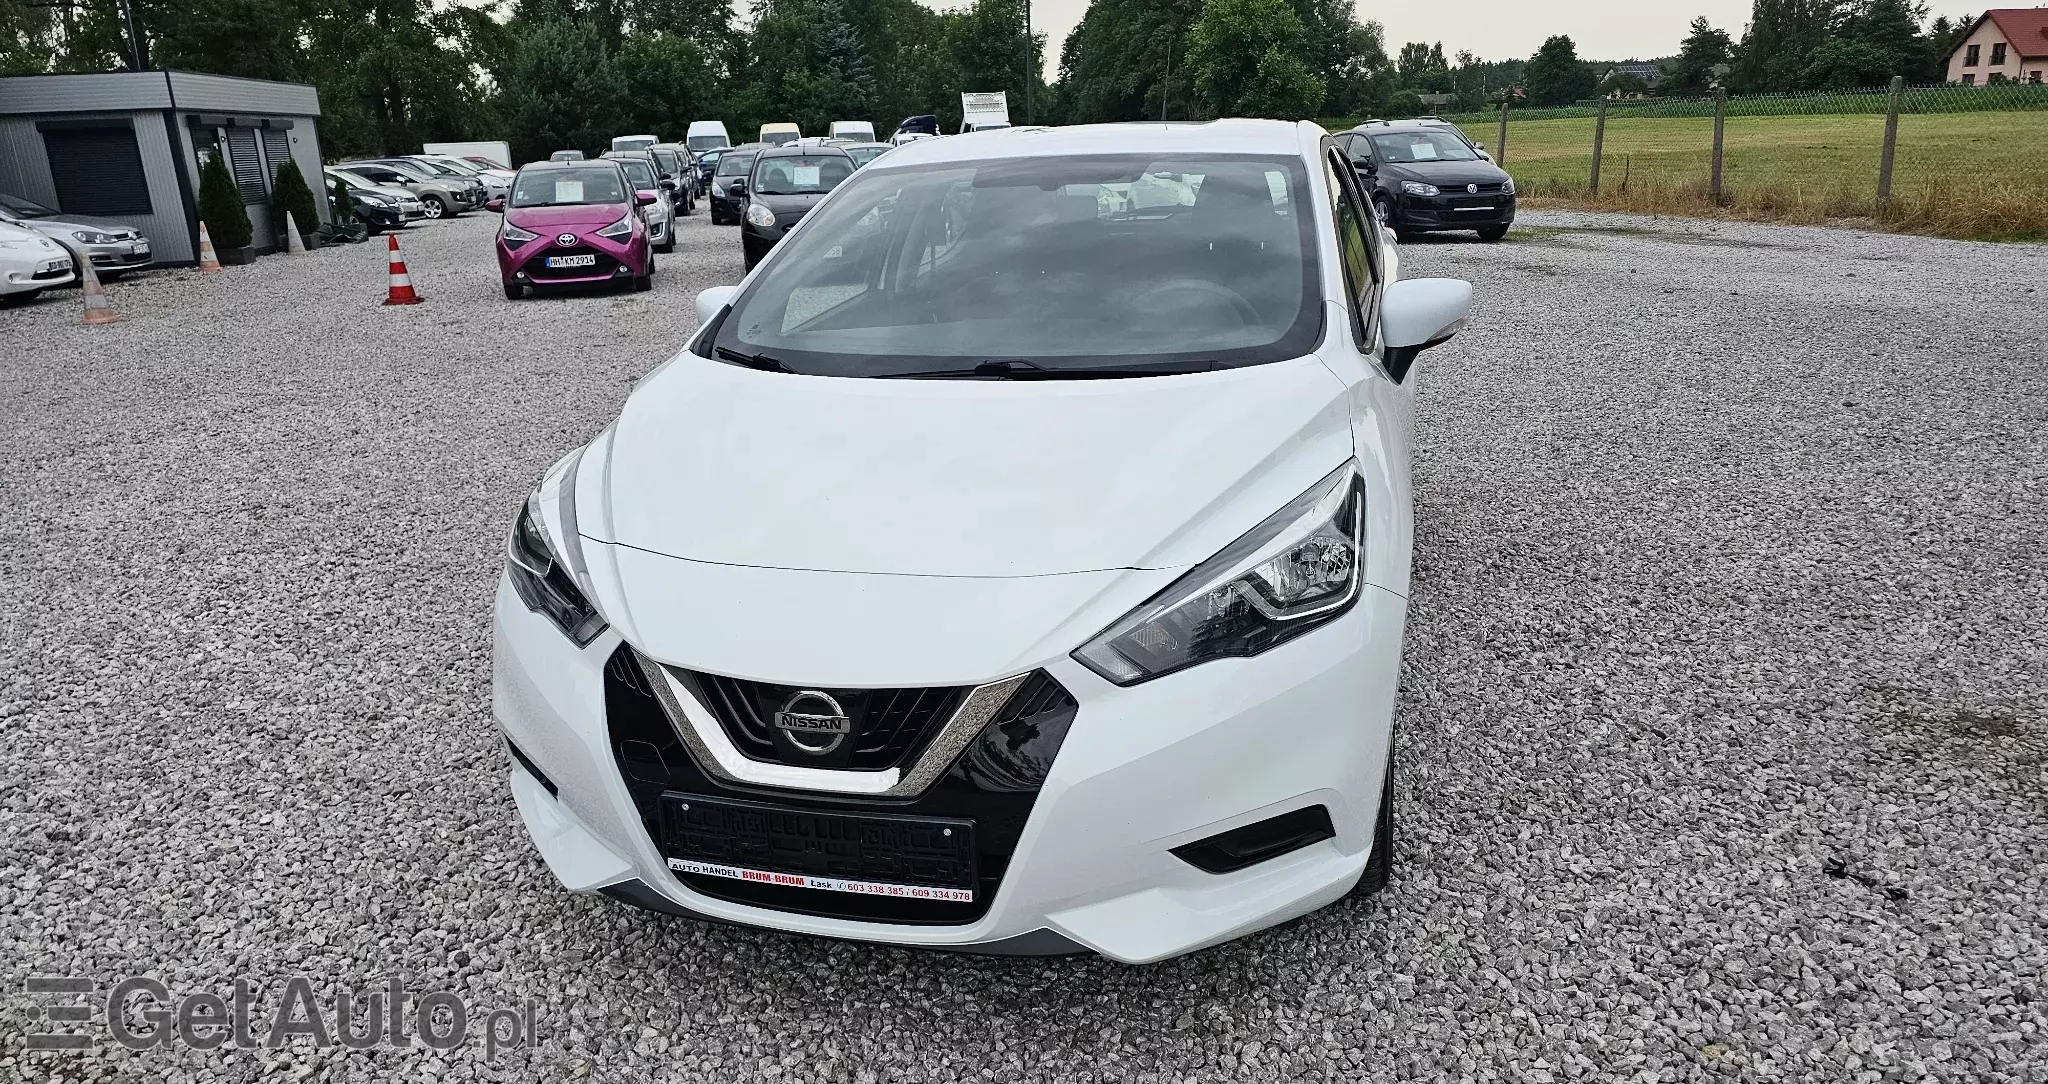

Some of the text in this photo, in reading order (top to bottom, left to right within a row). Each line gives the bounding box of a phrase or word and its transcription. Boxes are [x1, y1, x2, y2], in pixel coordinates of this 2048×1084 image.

[550, 256, 593, 266] HH KM 2914
[781, 715, 842, 729] NISSAN
[671, 863, 700, 873] AUTO
[702, 865, 739, 878] HANDEL
[742, 871, 805, 885] BRUM-BRUM
[810, 879, 832, 889] Łask
[847, 883, 865, 892] 603
[867, 884, 884, 894] 338
[887, 886, 904, 895] 385
[912, 888, 929, 898] 609
[932, 890, 950, 899] 334
[952, 891, 970, 901] 978
